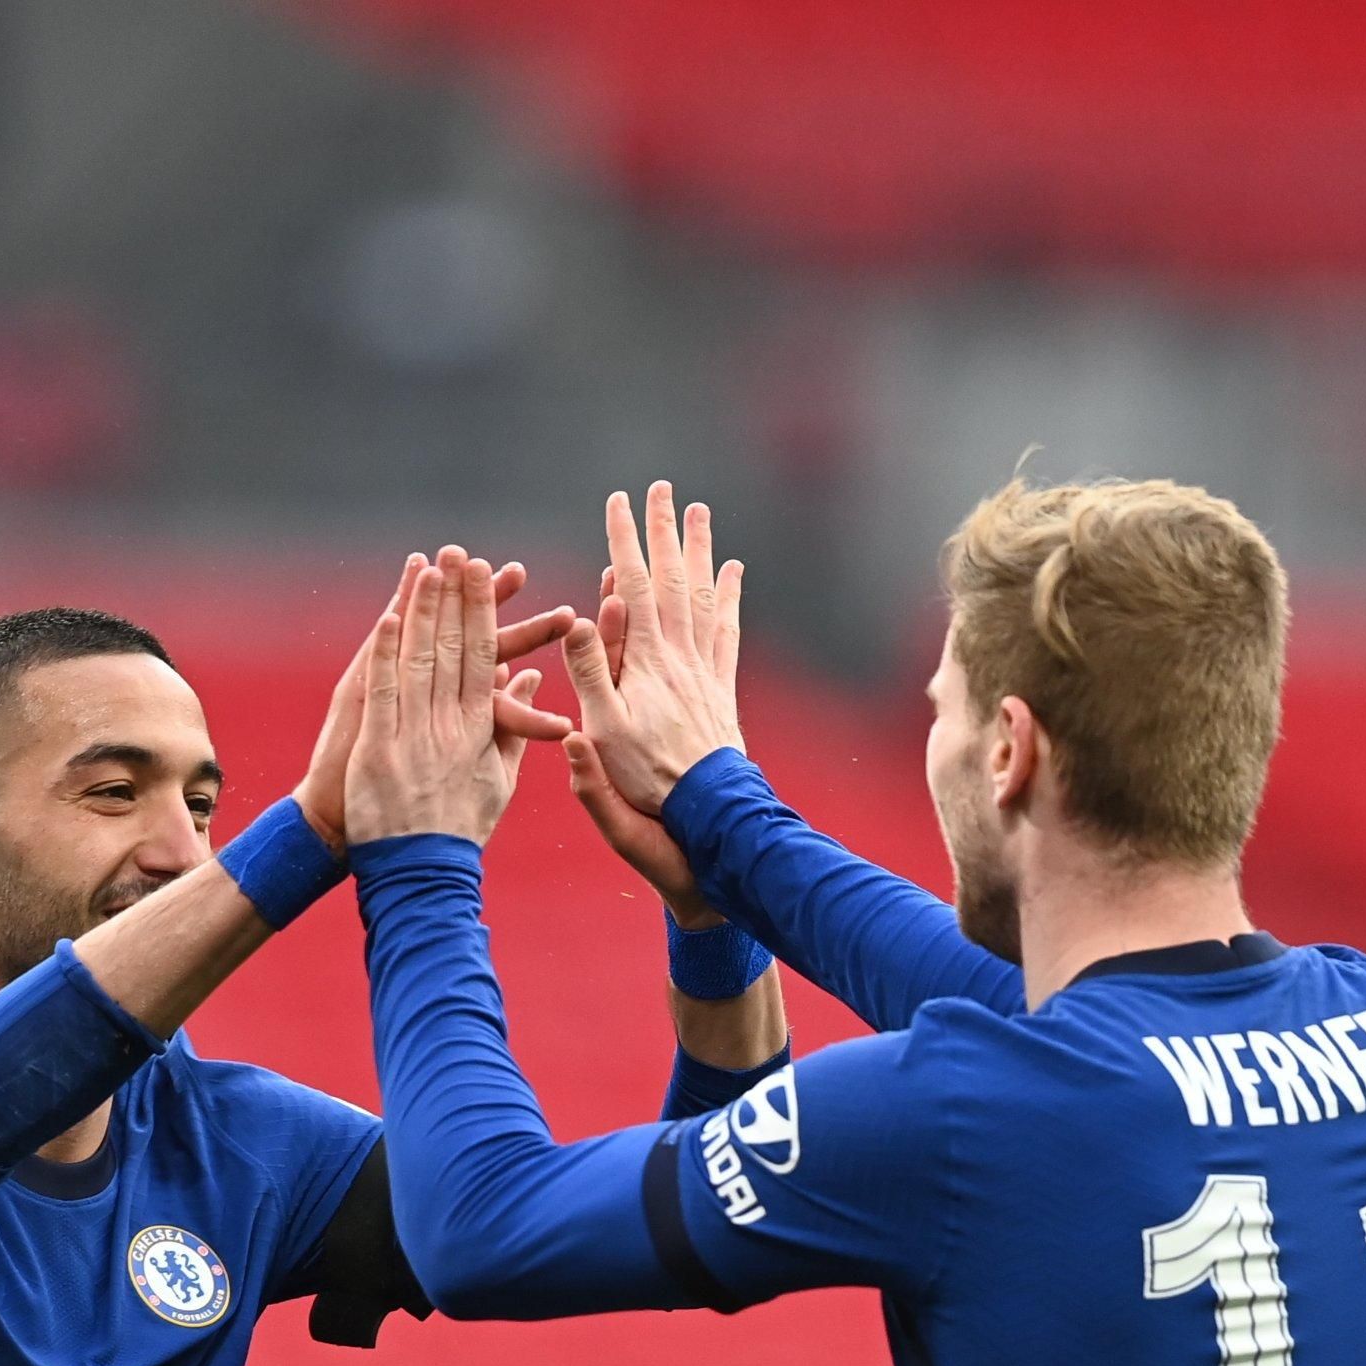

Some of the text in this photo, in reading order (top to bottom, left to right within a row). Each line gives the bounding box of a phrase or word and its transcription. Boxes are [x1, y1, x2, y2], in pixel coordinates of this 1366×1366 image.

[133, 1229, 184, 1261] CHELSEA
[172, 1289, 225, 1321] FOOTBALL CLUB
